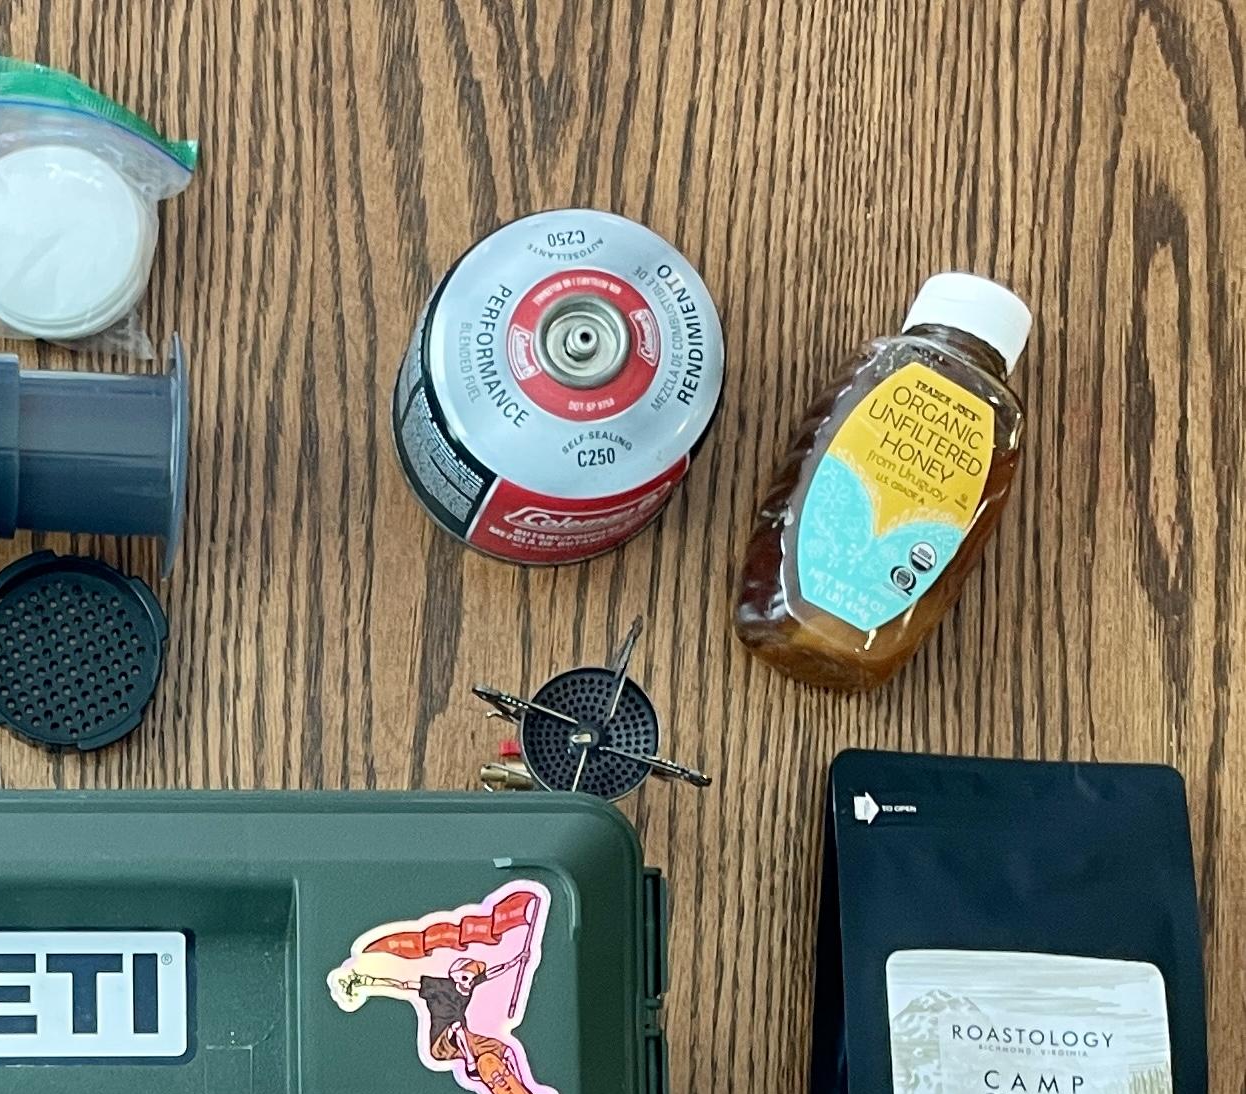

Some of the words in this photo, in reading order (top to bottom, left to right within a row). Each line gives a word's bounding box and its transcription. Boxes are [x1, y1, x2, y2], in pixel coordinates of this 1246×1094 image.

[527, 237, 604, 261] AUTOSELLANTE
[548, 230, 585, 248] C250
[633, 265, 648, 281] DE
[646, 280, 683, 350] COMBUSTIBLE
[656, 264, 703, 406] RENDIMIENTO
[459, 321, 472, 375] BLENDED
[466, 374, 481, 403] FUEL
[476, 284, 530, 428] PERFORMANCE
[670, 352, 683, 370] DE
[651, 370, 679, 412] MEZCLA
[915, 380, 952, 406] TRADER
[893, 386, 984, 450] ORGANIC
[562, 431, 633, 455] SELF-SEALING
[869, 398, 983, 477] UNFILTERED
[577, 447, 615, 468] C250
[880, 431, 955, 484] HONEY
[866, 450, 897, 472] from
[898, 464, 948, 503] Uruguay
[890, 480, 918, 500] GRADE
[918, 497, 925, 505] A
[881, 804, 893, 812] TO
[894, 804, 917, 813] OPEN
[952, 1024, 1114, 1048] ROASTOLOGY
[1041, 1048, 1089, 1057] VIRGINIA
[984, 1070, 1085, 1094] CAMP
